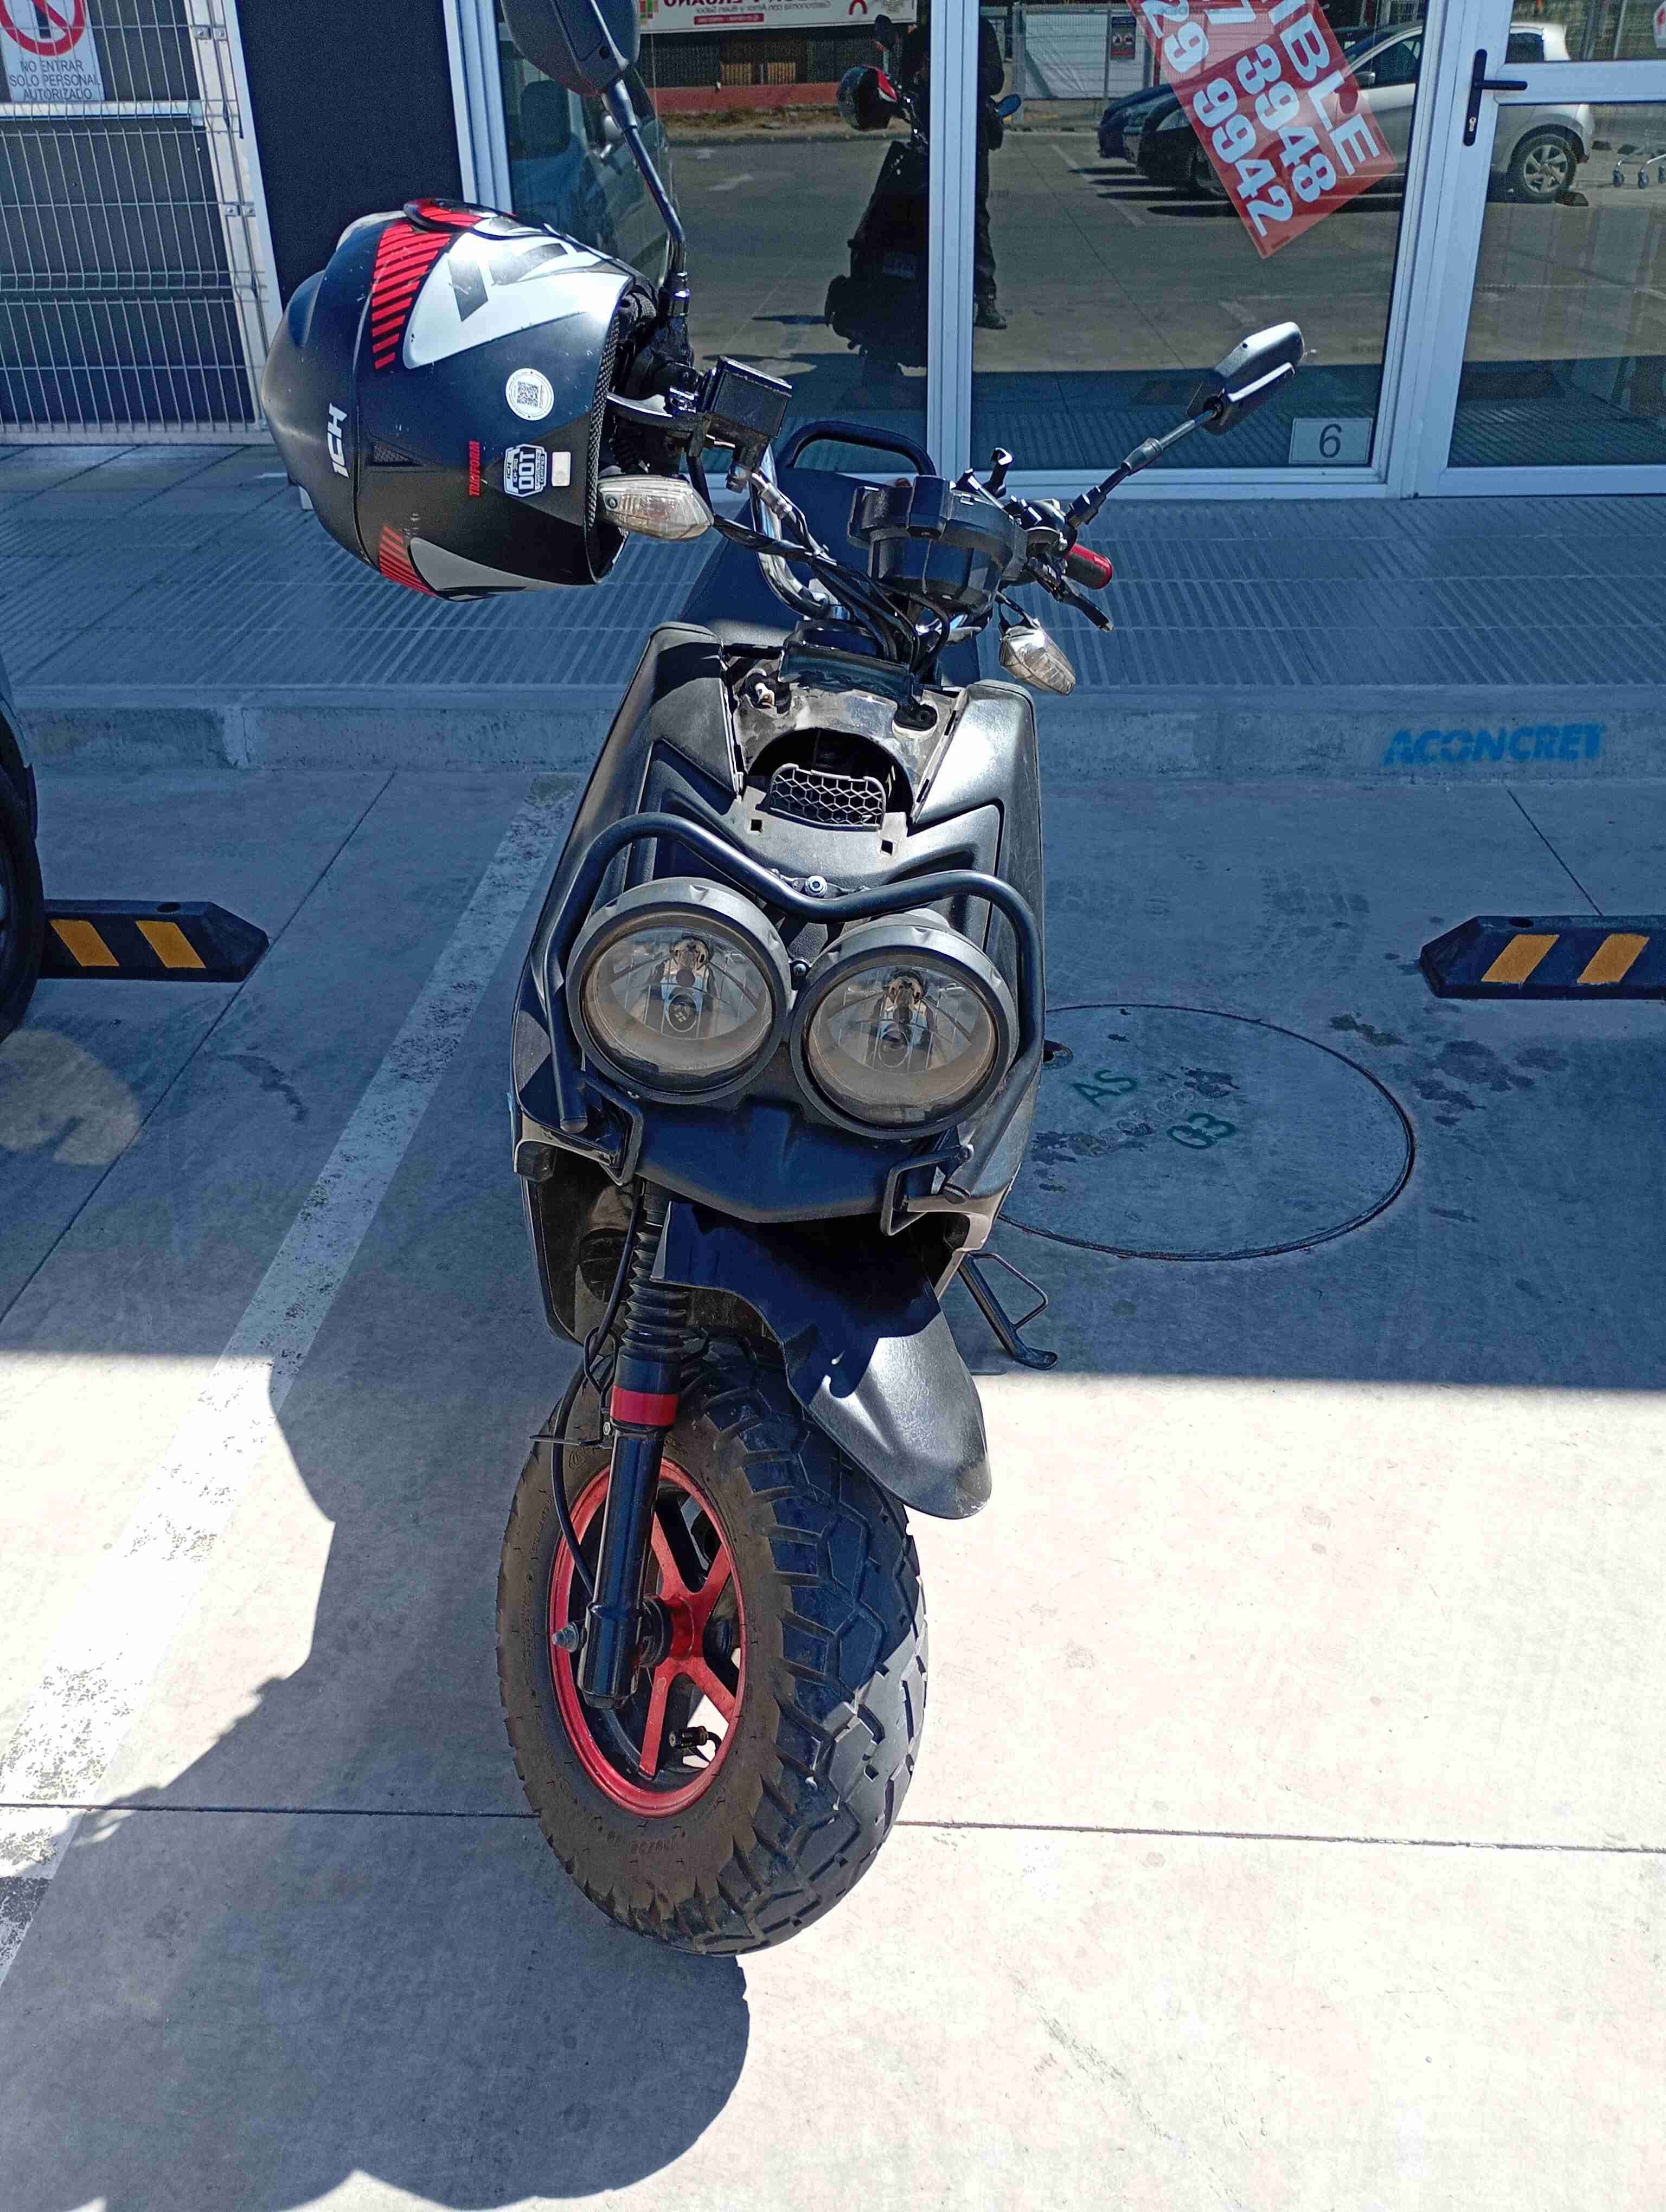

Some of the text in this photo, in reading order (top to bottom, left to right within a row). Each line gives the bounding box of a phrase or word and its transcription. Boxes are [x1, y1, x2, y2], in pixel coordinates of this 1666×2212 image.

[10, 74, 100, 87] SOLO PERSONAL
[20, 60, 84, 72] NO ENTRAR
[24, 88, 92, 100] AUTORIZADO
[1262, 0, 1380, 176] IBLE
[1236, 43, 1336, 203] 3948
[1194, 78, 1293, 237] 9942
[1318, 423, 1343, 459] 6
[518, 451, 535, 490] DOT
[1072, 1069, 1137, 1107] AS
